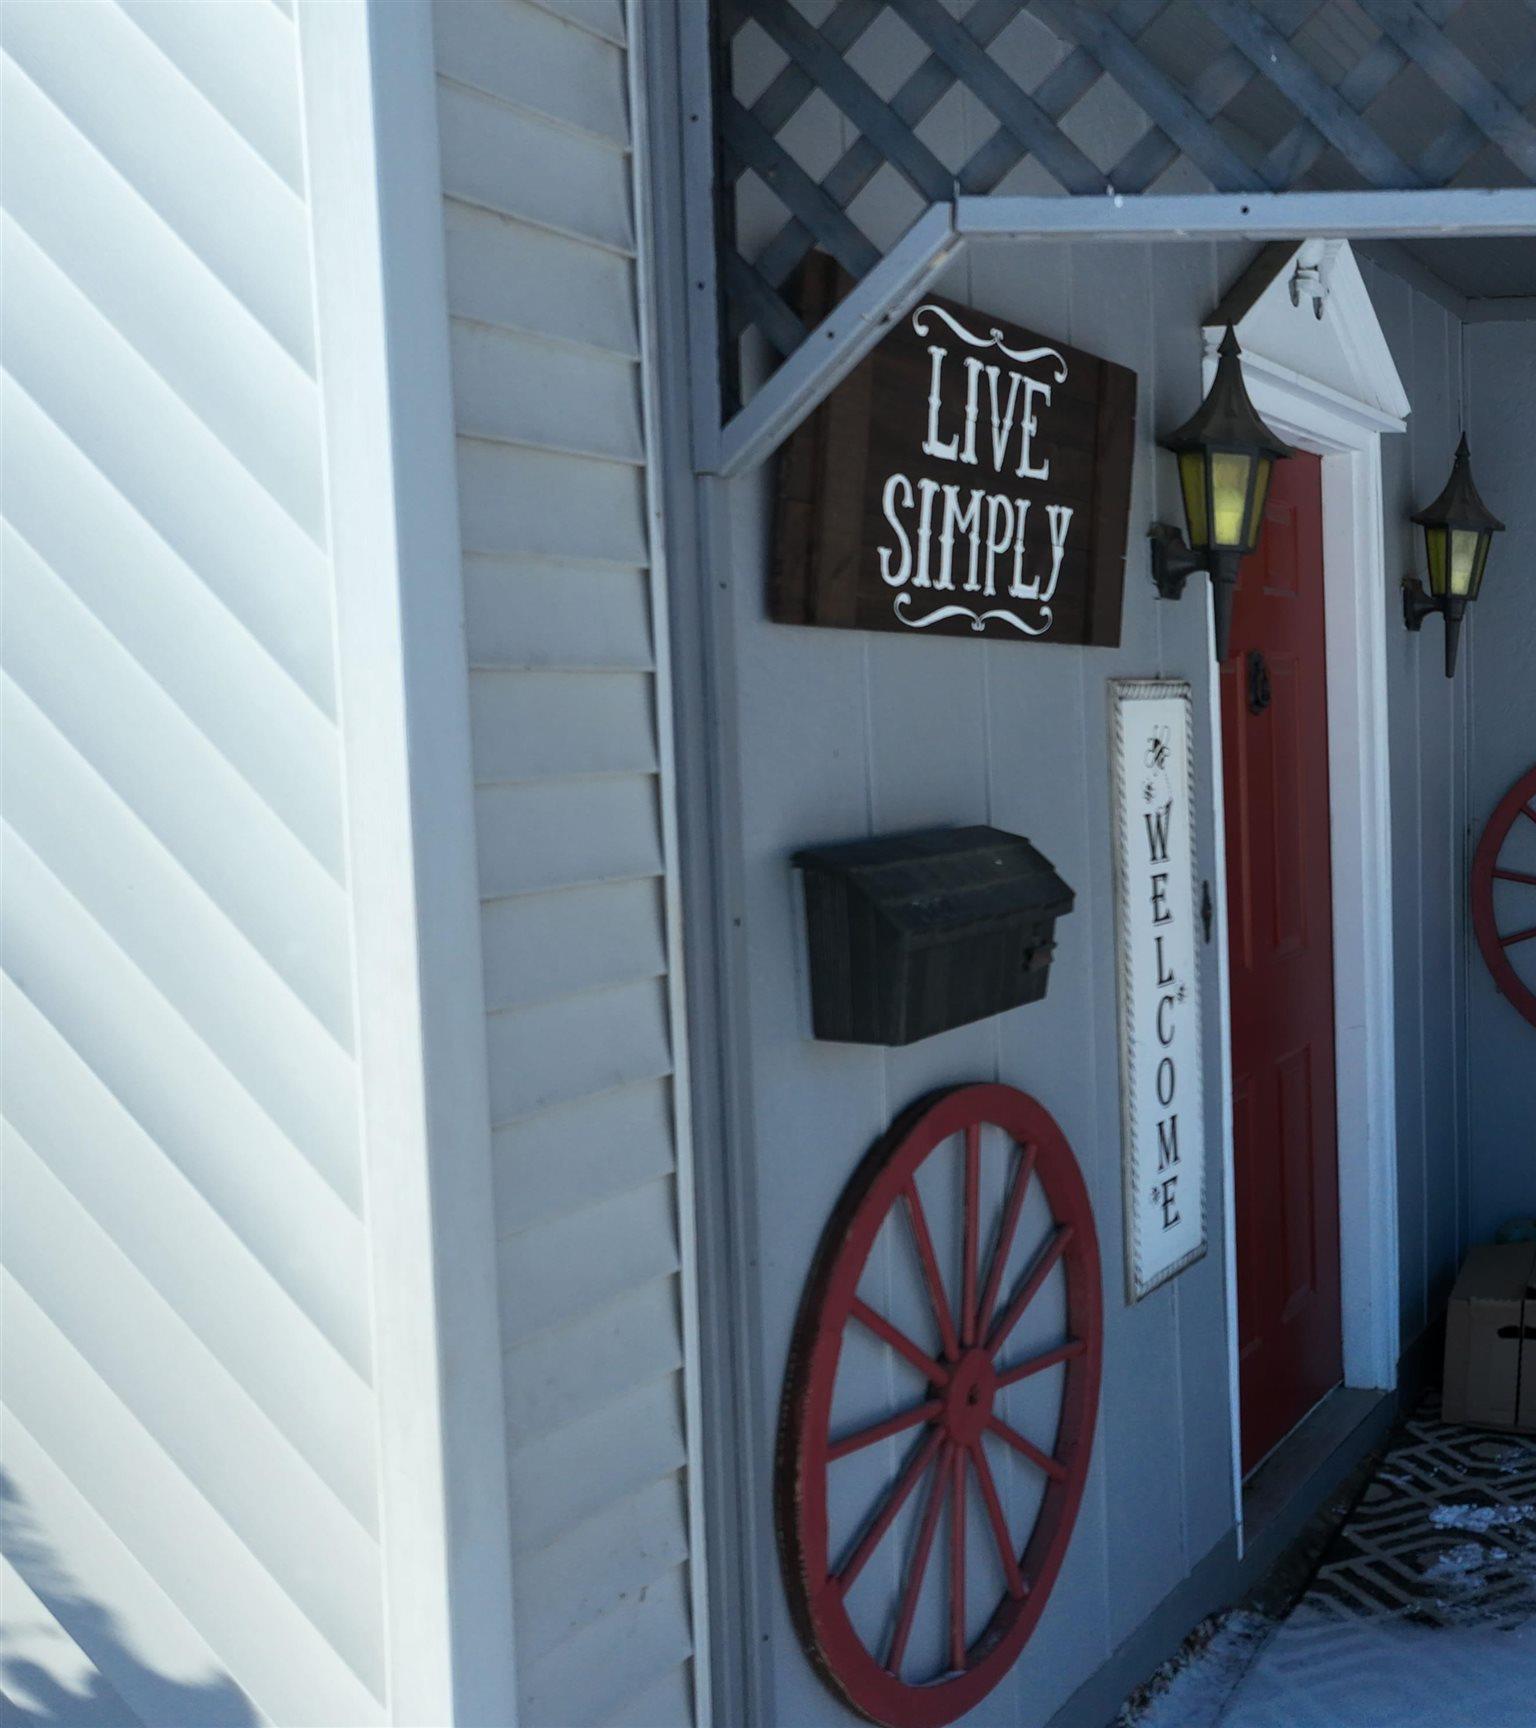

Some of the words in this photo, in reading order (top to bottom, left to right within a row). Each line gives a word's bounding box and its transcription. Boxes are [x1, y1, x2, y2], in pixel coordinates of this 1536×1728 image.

[922, 345, 1052, 481] LIVE
[877, 473, 1074, 602] SIMPLY
[1144, 806, 1182, 1232] WELCOME
